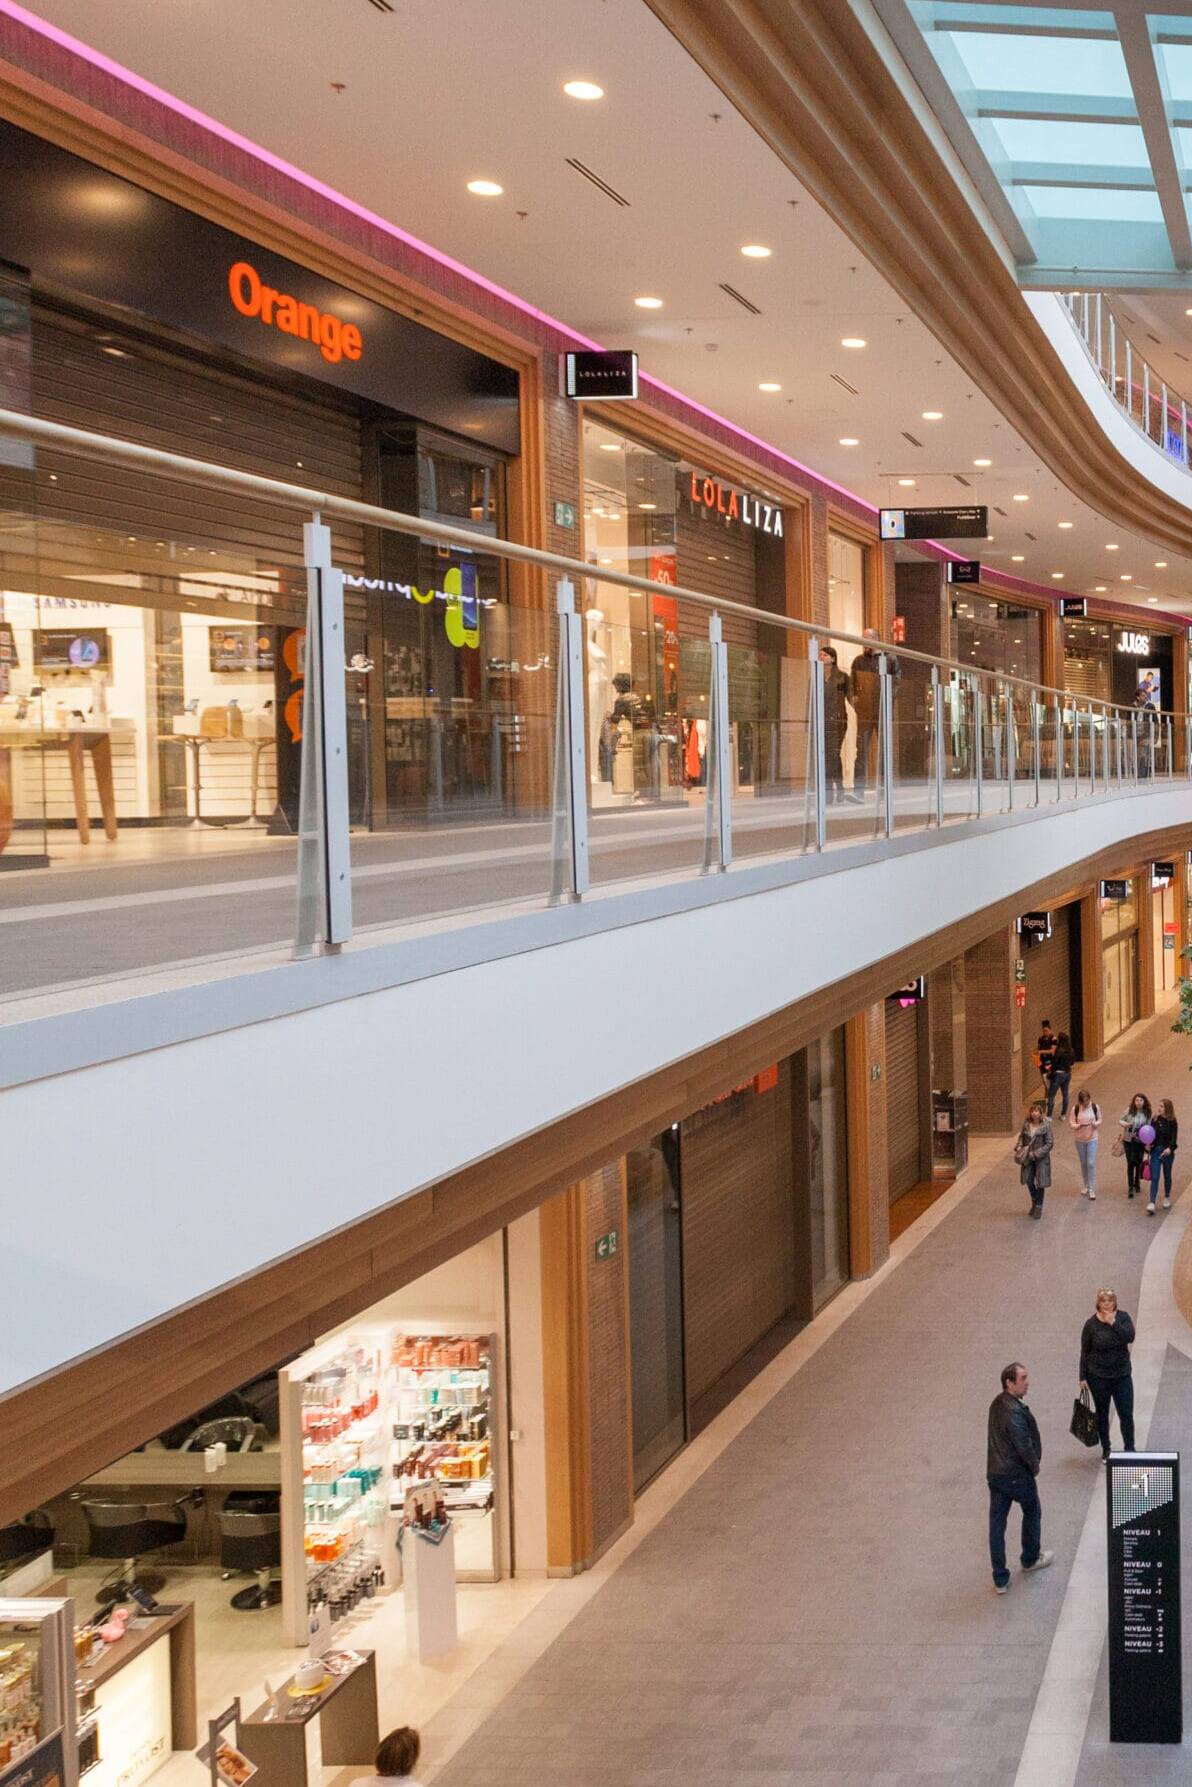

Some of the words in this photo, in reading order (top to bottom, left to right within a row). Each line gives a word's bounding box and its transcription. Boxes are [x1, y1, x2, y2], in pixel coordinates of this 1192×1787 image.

[228, 261, 364, 365] Orange
[1131, 1473, 1149, 1497] -1
[1124, 1640, 1152, 1648] NIVEAU
